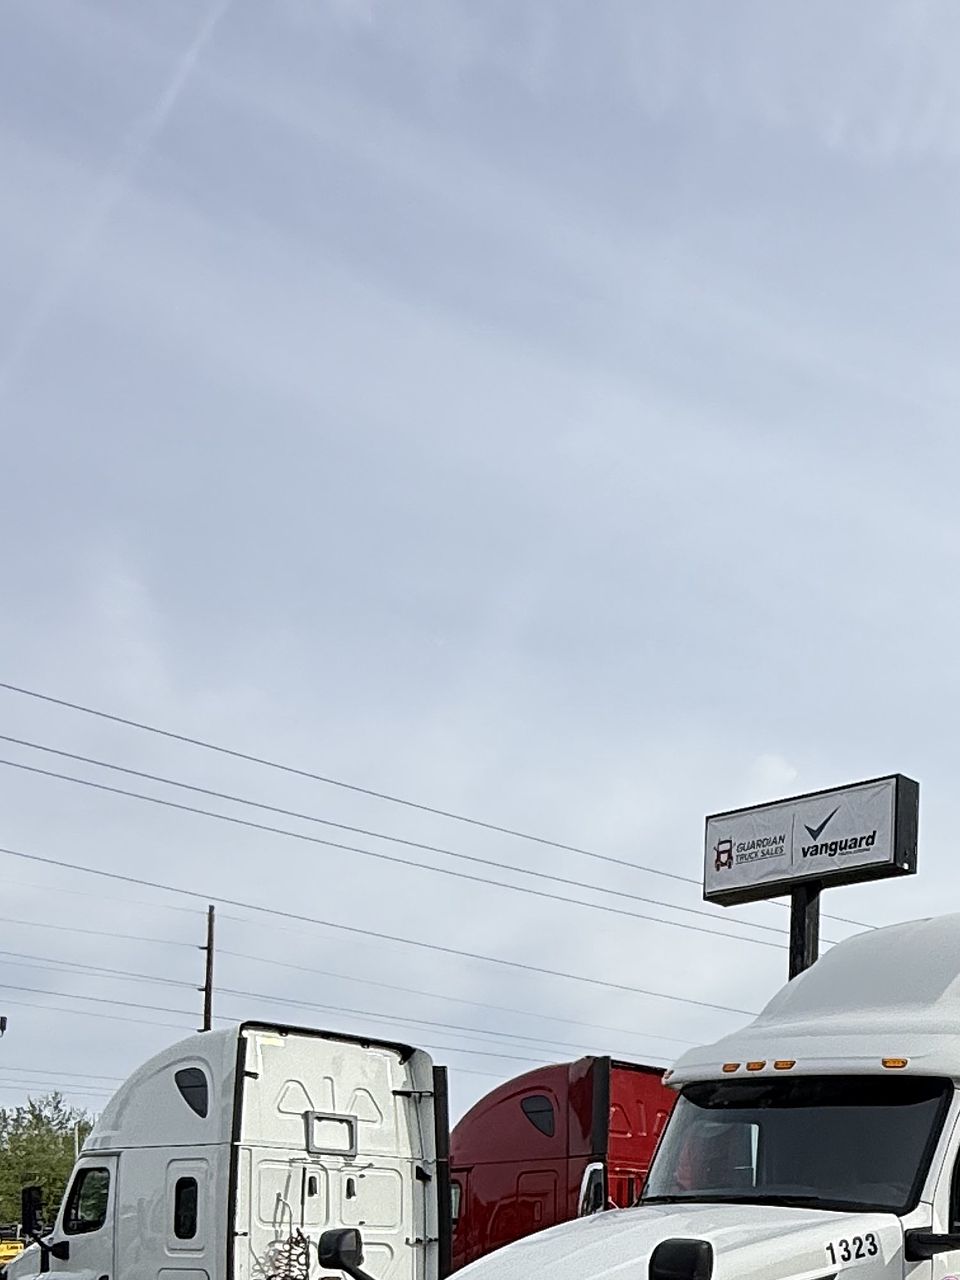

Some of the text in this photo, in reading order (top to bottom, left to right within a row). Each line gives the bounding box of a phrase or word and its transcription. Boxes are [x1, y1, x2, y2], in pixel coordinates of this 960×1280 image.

[736, 834, 786, 853] GUARDIAN
[760, 845, 785, 857] SALES
[801, 830, 877, 858] vanguard
[826, 1233, 878, 1265] 1323
